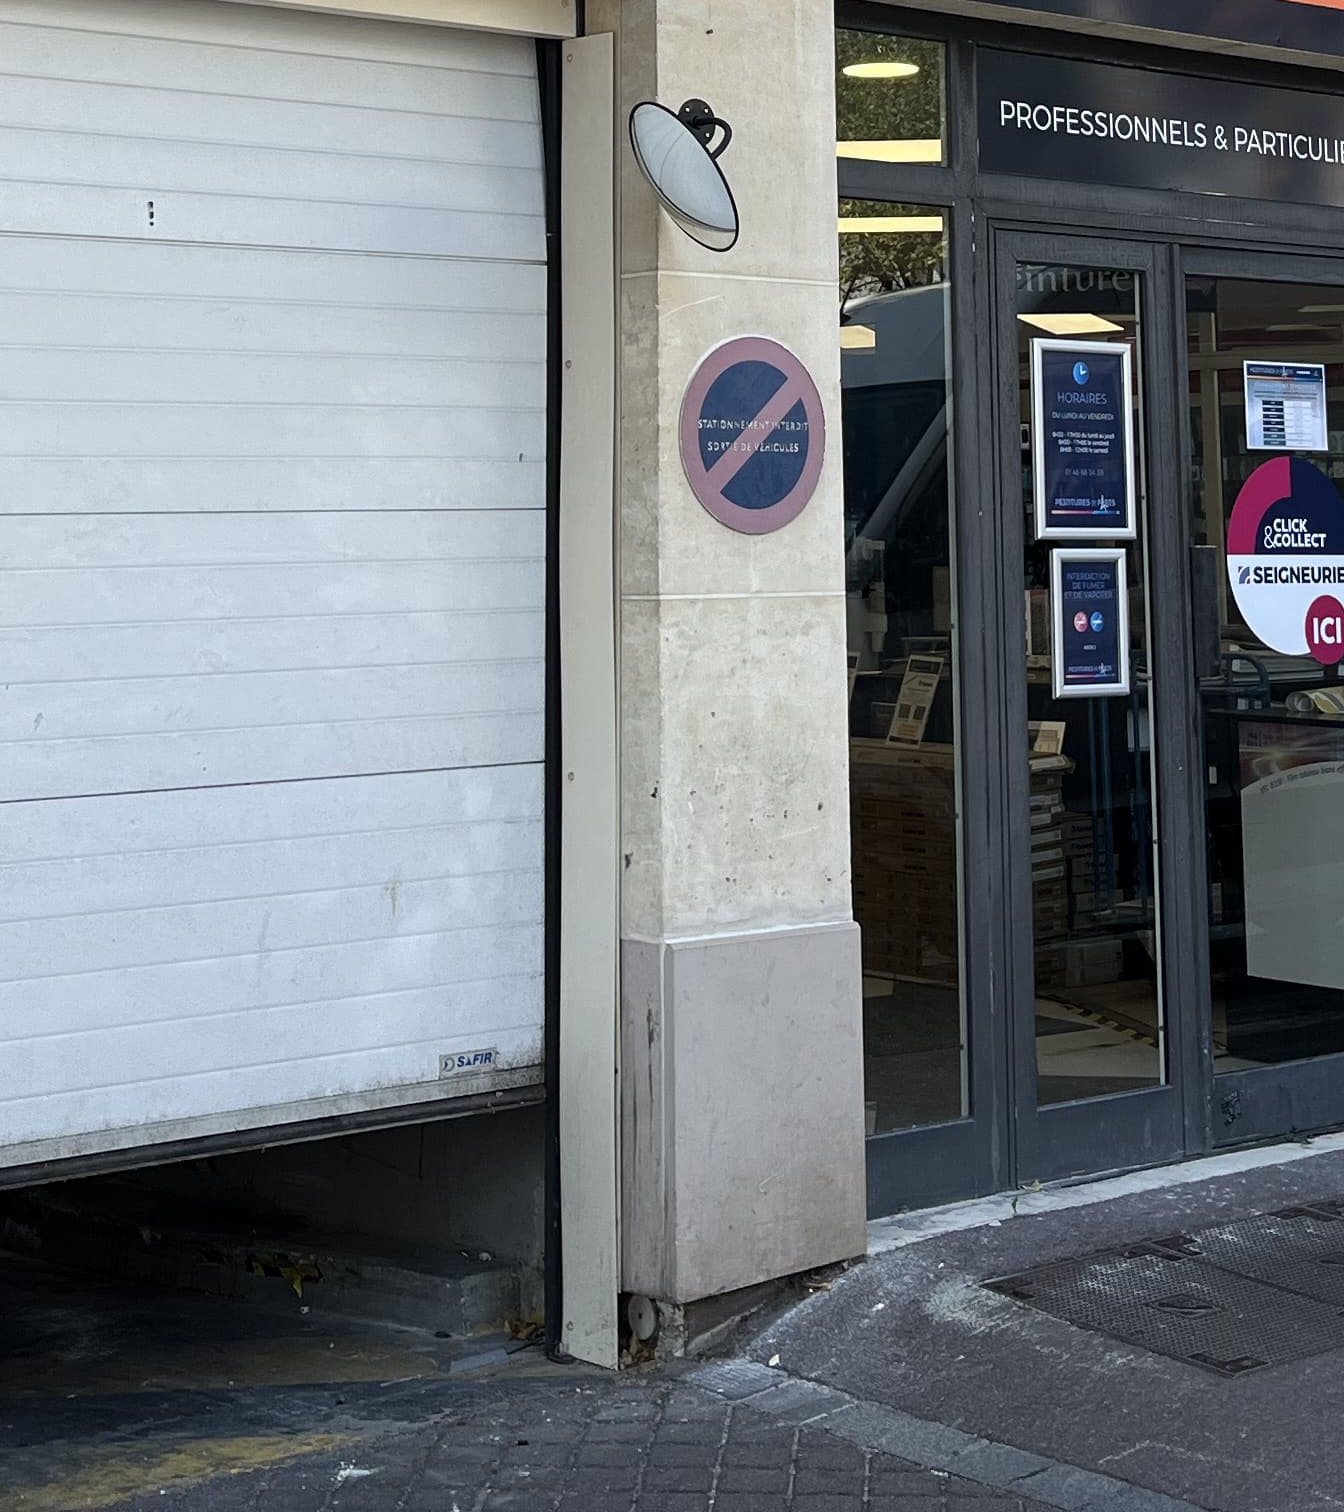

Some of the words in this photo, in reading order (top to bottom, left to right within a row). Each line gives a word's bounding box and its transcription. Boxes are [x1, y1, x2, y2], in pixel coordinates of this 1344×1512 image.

[999, 100, 1207, 148] PROFESSIONNELS
[1214, 125, 1230, 152] &
[1056, 392, 1108, 405] HORAIRES
[1273, 518, 1308, 533] CLICK
[1274, 533, 1327, 548] COLLECT
[1312, 616, 1342, 645] ICI
